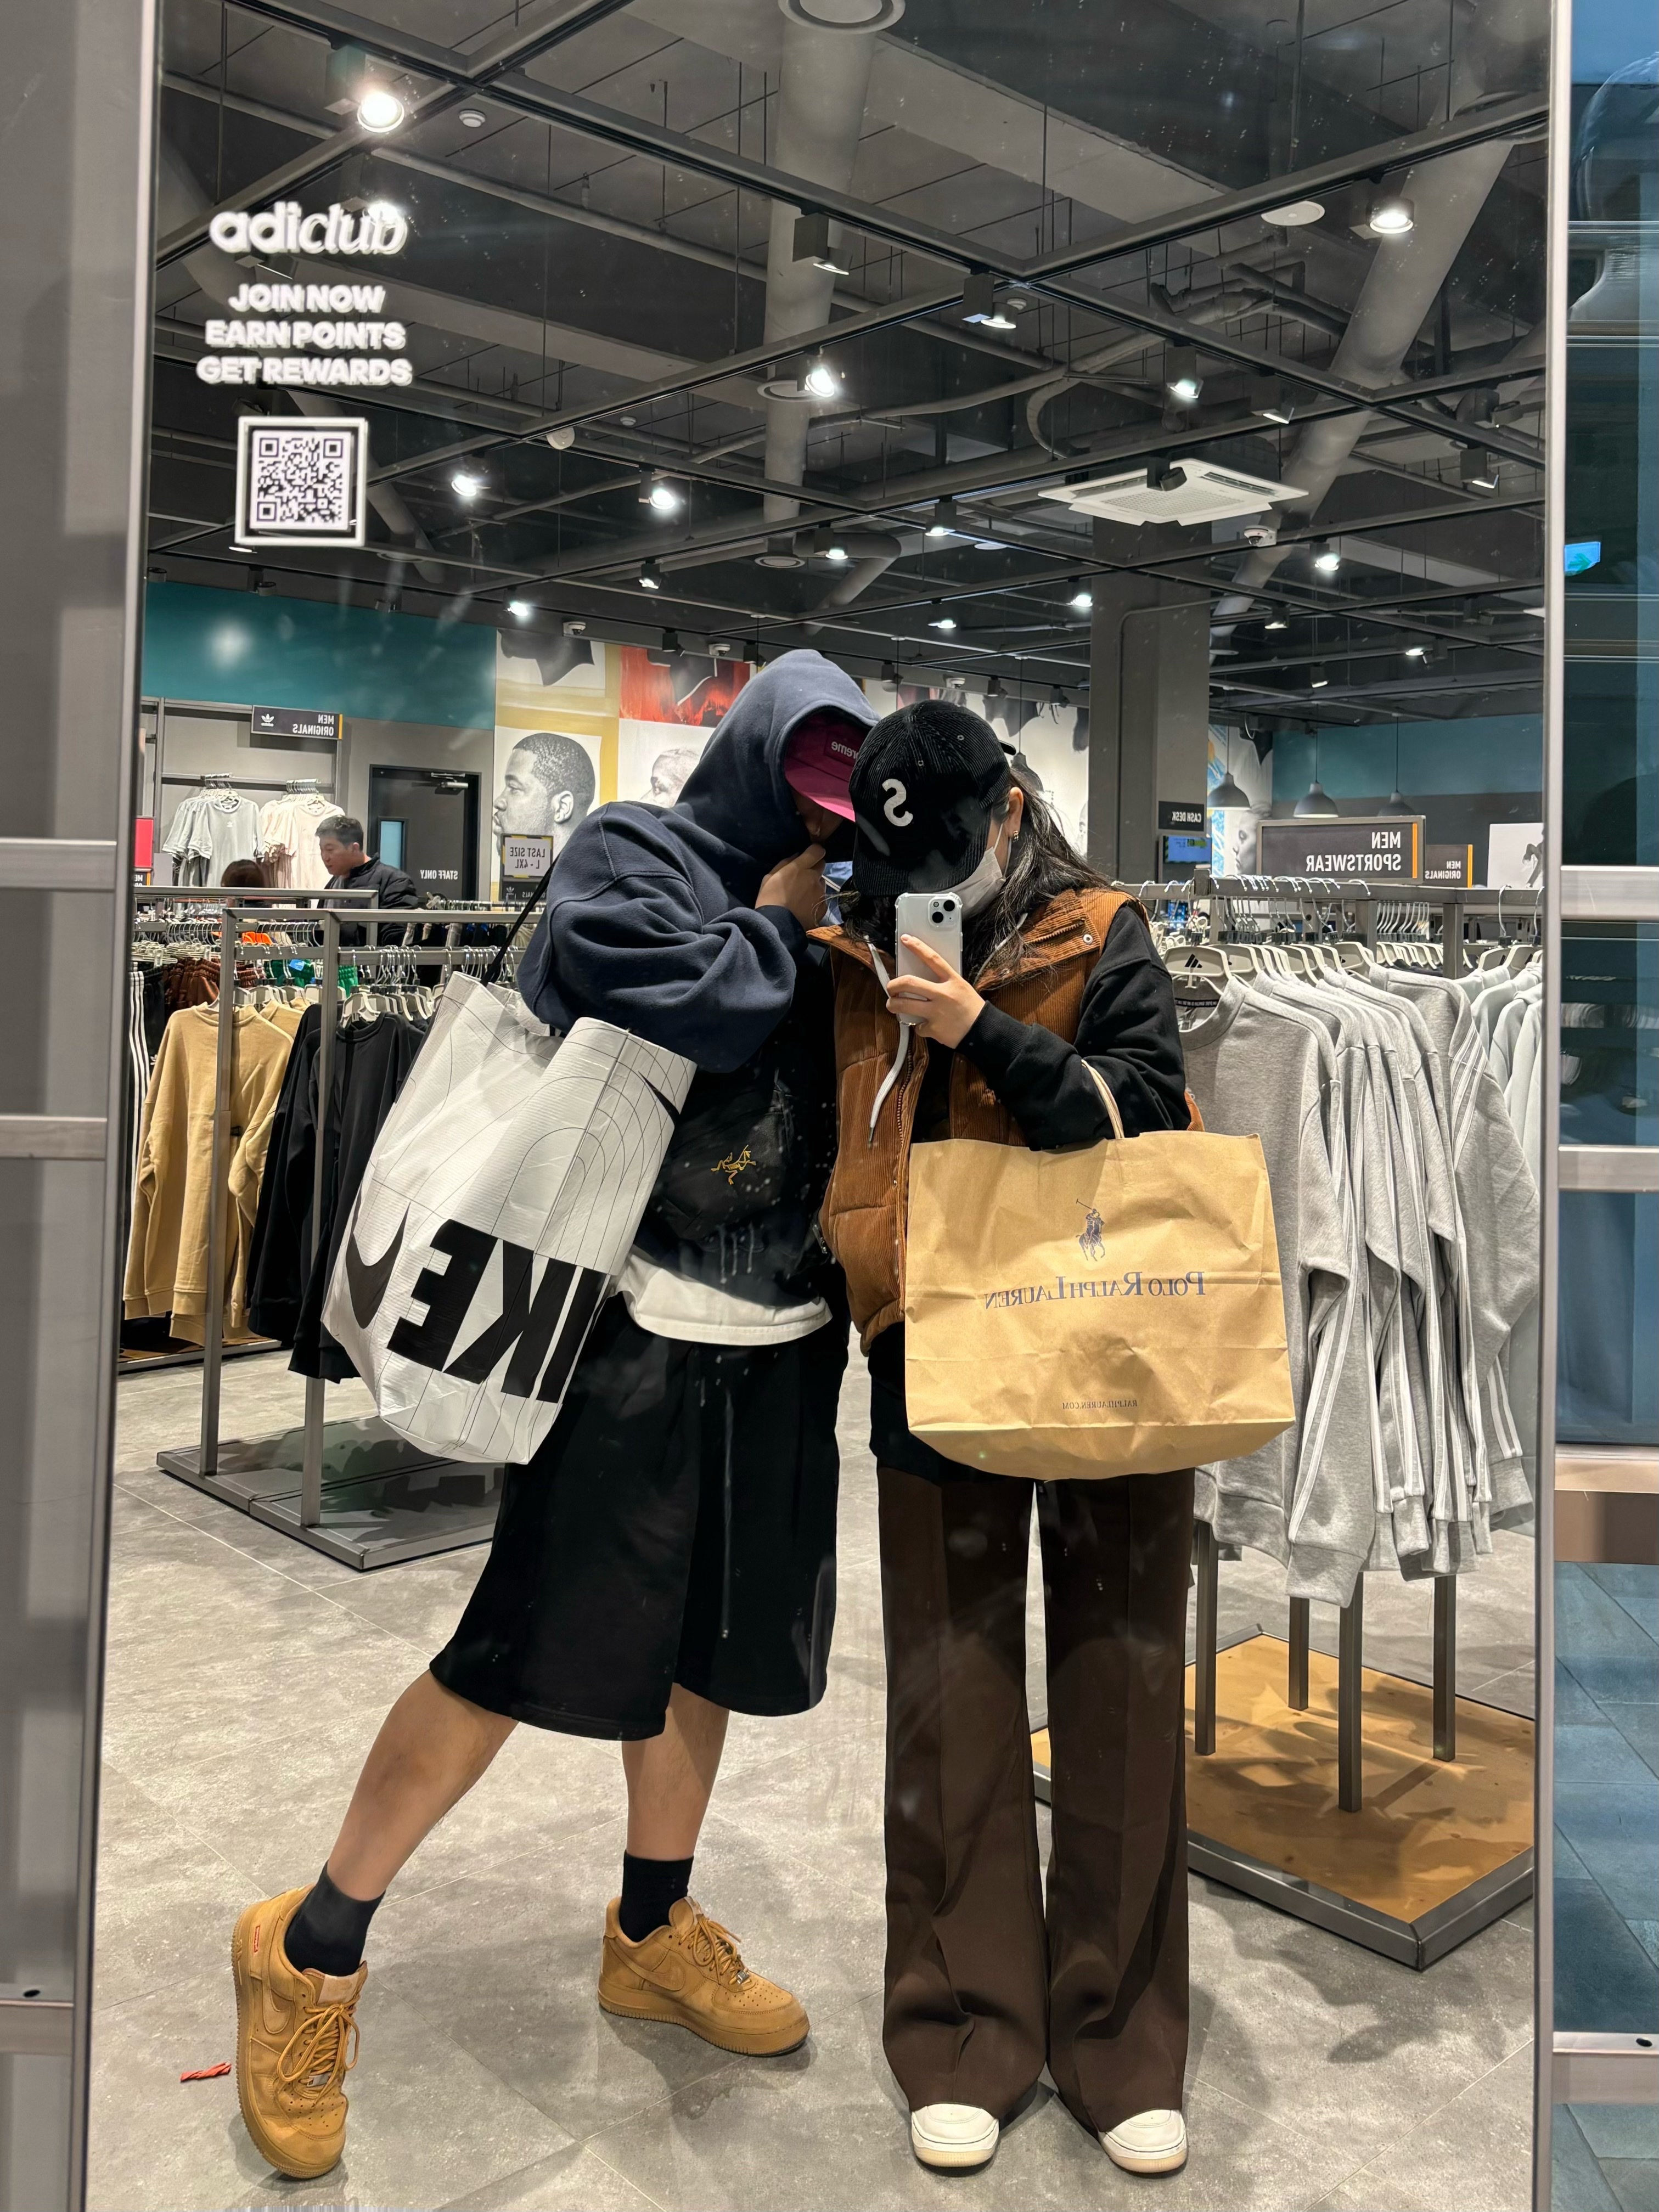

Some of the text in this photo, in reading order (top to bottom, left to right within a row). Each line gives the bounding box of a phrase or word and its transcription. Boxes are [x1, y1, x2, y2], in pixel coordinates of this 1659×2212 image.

[210, 201, 407, 254] adiclub
[228, 283, 385, 313] JOIN NOW
[205, 319, 406, 350] EARN POINTS
[196, 356, 413, 386] GET REWARDS
